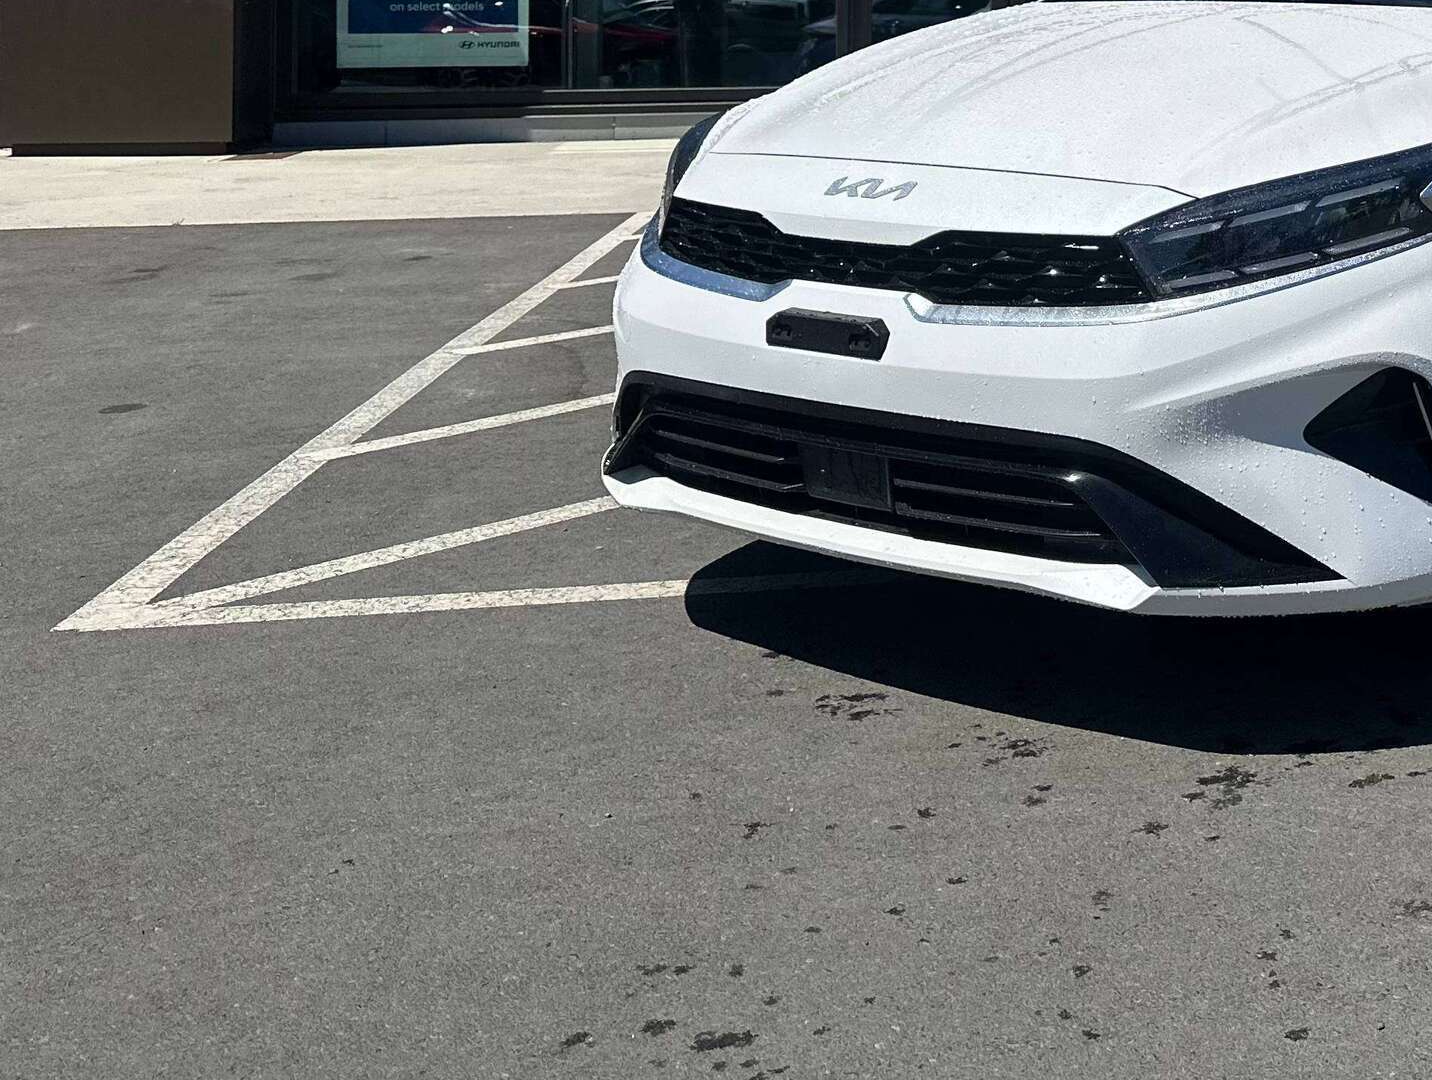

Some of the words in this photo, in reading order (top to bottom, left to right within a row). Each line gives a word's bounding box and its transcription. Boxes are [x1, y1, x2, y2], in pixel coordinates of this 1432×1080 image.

[389, 3, 405, 12] on
[407, 1, 440, 12] select
[477, 41, 520, 49] HYUNDAI
